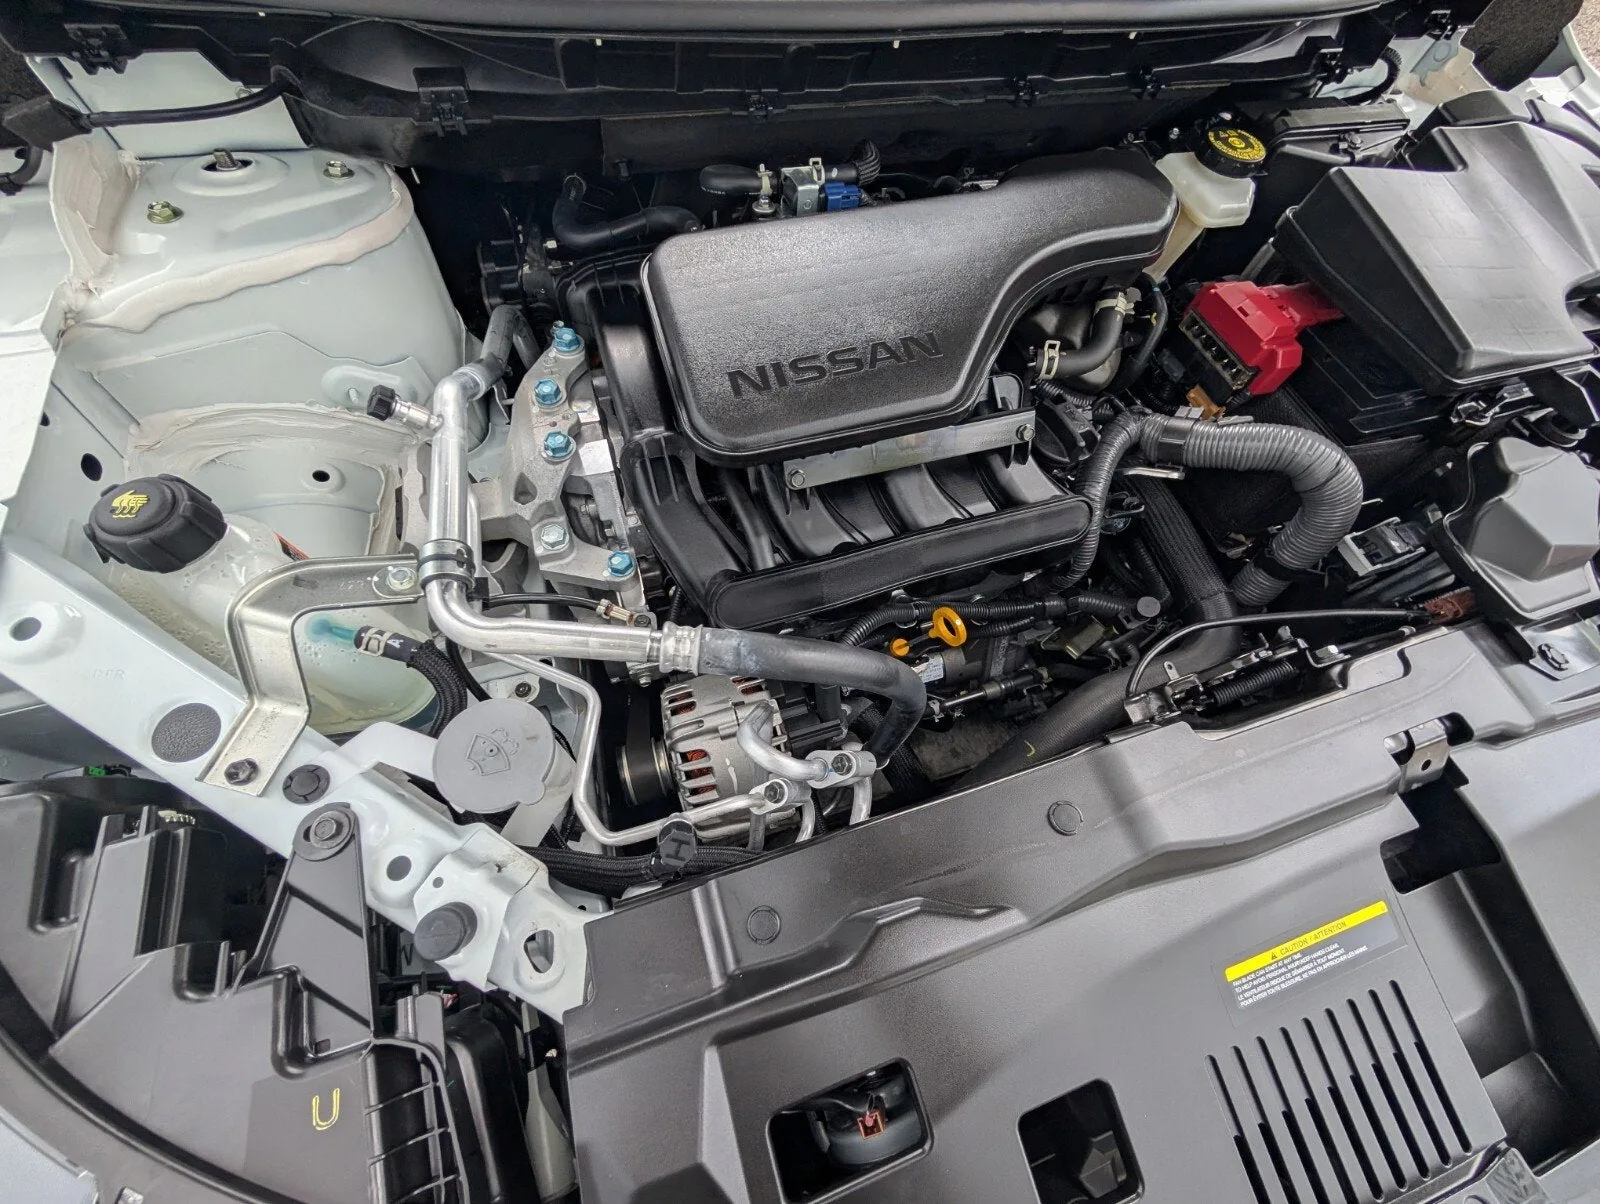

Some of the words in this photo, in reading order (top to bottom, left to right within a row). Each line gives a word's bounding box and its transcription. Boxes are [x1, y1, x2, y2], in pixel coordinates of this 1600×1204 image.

[726, 330, 943, 398] NISSAN
[1278, 938, 1308, 955] CAUTION
[1312, 920, 1347, 940] ATTENTION
[1231, 978, 1242, 987] FAN
[1240, 972, 1256, 983] BLADE
[1254, 968, 1265, 977] CAN
[1264, 962, 1278, 972] START
[1276, 959, 1284, 967] AT
[1282, 955, 1293, 964] ANY
[1234, 985, 1242, 993] TO
[1240, 980, 1253, 990] HELP
[1251, 974, 1266, 985] AVOID
[1264, 965, 1287, 979] PERSONAL
[1236, 993, 1244, 1001] LE
[1242, 981, 1270, 998] VENTILATEUR
[1268, 974, 1286, 986] RISQUE
[1284, 971, 1292, 979] DE
[1289, 960, 1314, 976] DÉMARRER
[1315, 955, 1328, 965] TOUT
[1239, 997, 1254, 1008] POUR
[1251, 989, 1268, 1002] ÉVITER
[1266, 984, 1281, 995] TOUTE
[1321, 954, 1347, 970] APPROCHER
[1345, 950, 1355, 959] LES
[312, 1087, 340, 1131] U
